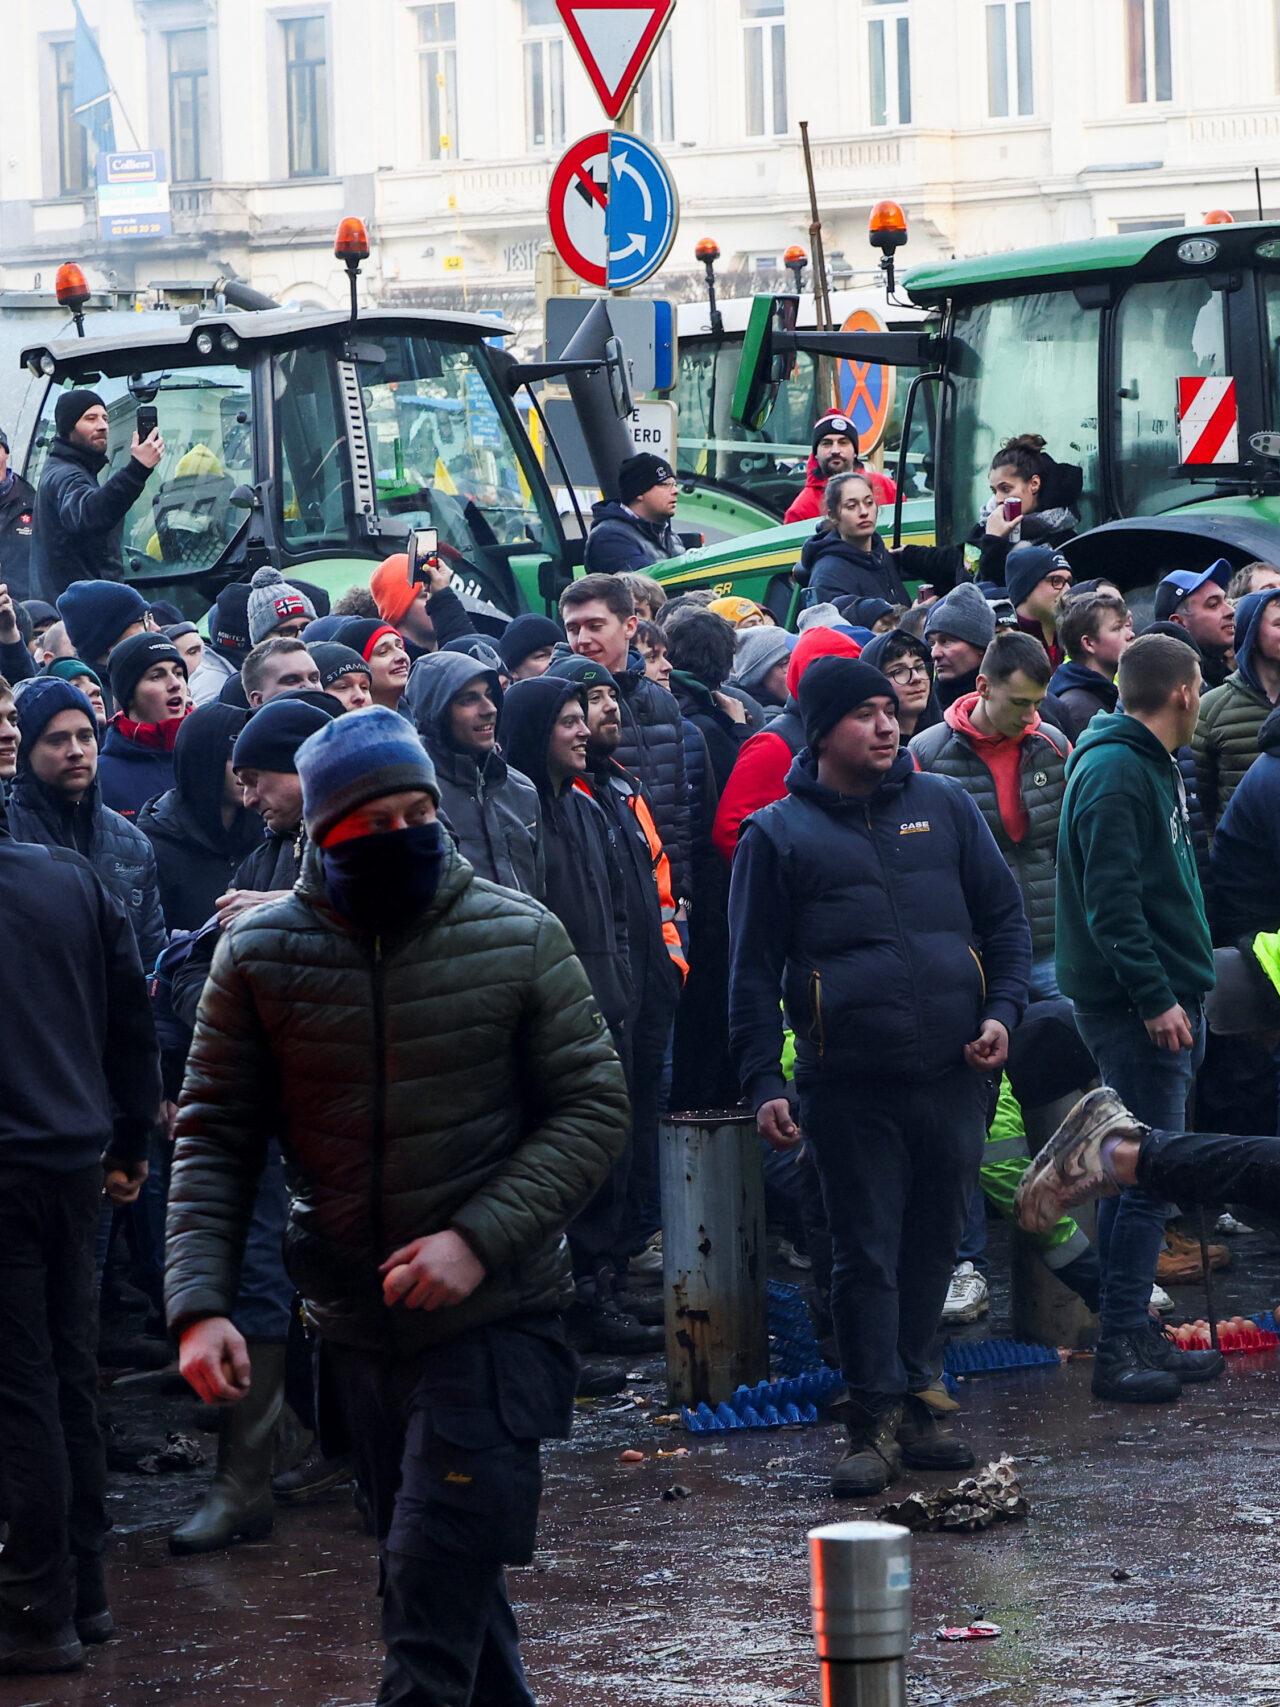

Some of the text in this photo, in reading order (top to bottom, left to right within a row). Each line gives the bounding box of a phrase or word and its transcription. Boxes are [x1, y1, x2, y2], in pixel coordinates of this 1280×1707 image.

[112, 158, 151, 171] Colliers
[630, 428, 662, 444] ERD
[900, 820, 930, 830] CASE
